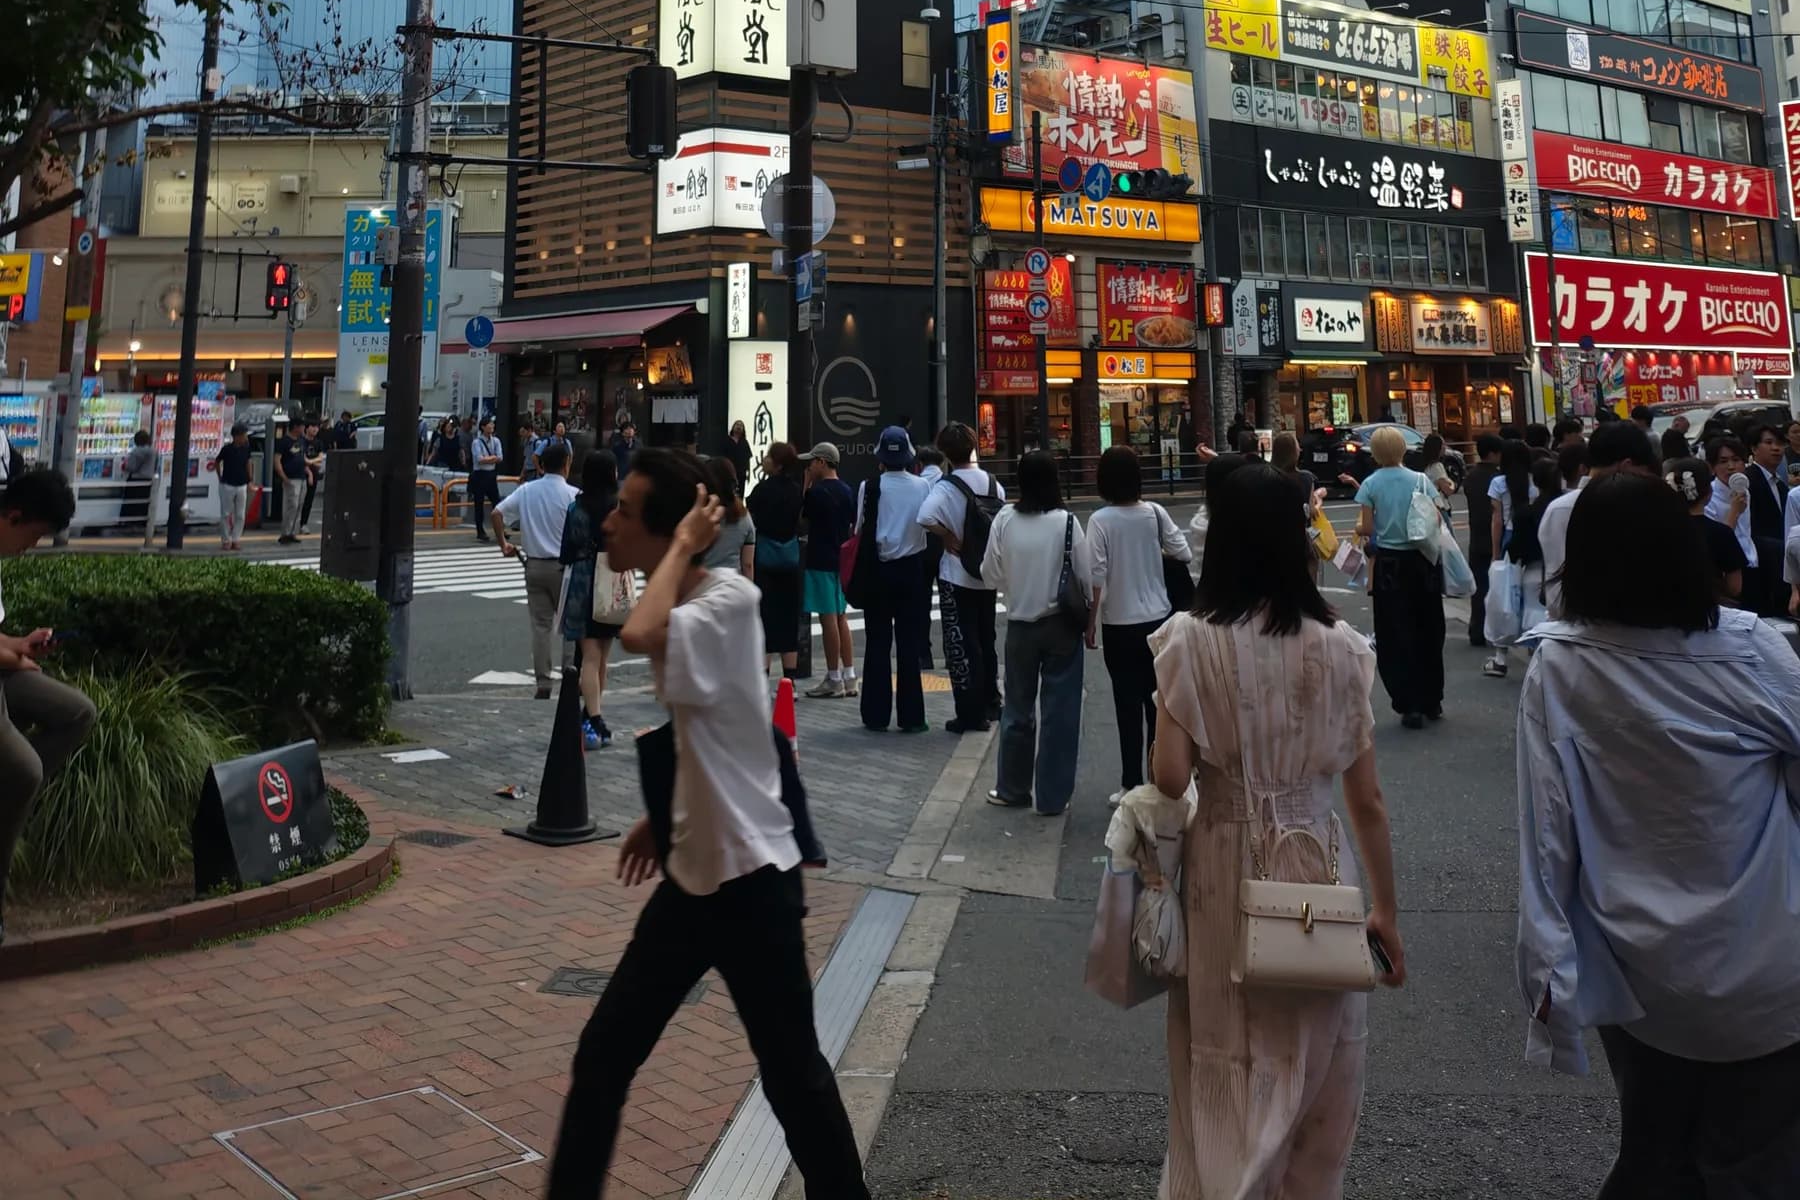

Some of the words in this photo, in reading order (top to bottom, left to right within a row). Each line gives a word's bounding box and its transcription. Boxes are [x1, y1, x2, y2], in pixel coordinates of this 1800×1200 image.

[1207, 8, 1277, 52] 生ビール
[993, 69, 1009, 116] 松屋
[1062, 69, 1127, 121] 情熱
[773, 146, 789, 159] 2F
[1370, 155, 1450, 213] 温野菜
[1567, 154, 1598, 182] BIG
[1599, 161, 1641, 191] ECHO
[1663, 162, 1752, 206] カラオケ
[1051, 202, 1161, 231] MATSUYA
[1547, 274, 1688, 334] カラオケ
[1705, 282, 1729, 294] Karaoke
[8, 294, 23, 320] P
[1699, 295, 1734, 331] BIG
[1735, 300, 1781, 333] ECHO
[1108, 319, 1134, 343] 2F
[1120, 357, 1146, 375] 松屋
